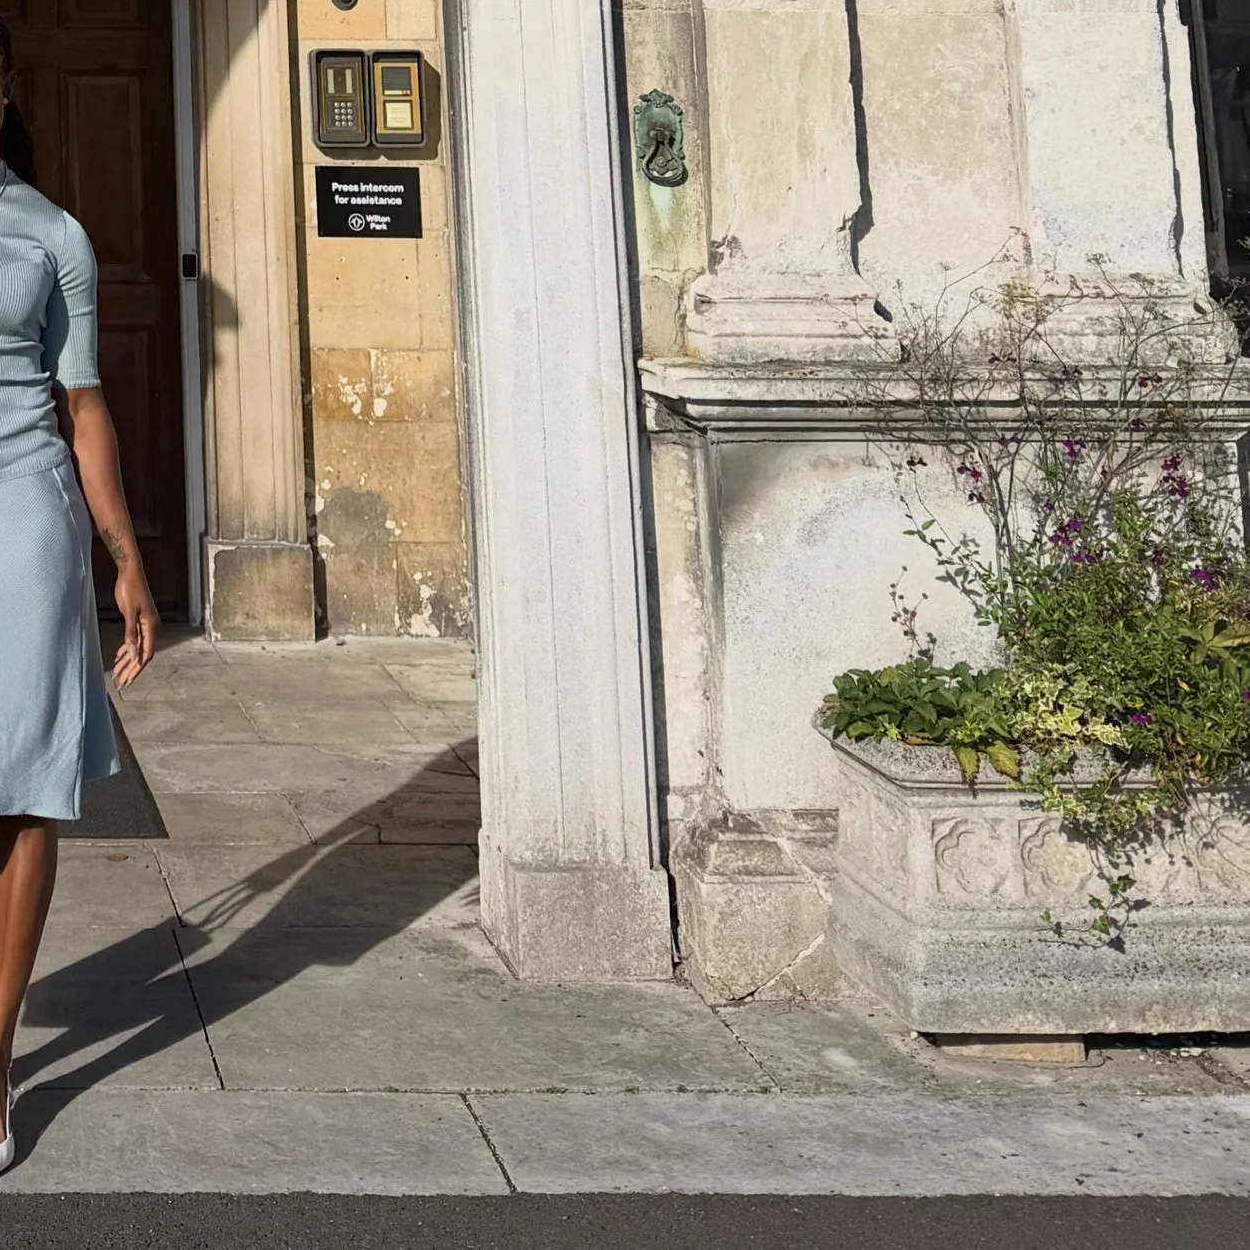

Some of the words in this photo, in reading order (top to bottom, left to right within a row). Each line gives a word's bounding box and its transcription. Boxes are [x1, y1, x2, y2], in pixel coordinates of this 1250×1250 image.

[331, 182, 359, 192] Press
[360, 182, 404, 192] intercom
[334, 194, 349, 204] for
[350, 195, 402, 205] assistance
[365, 214, 391, 223] Wilton
